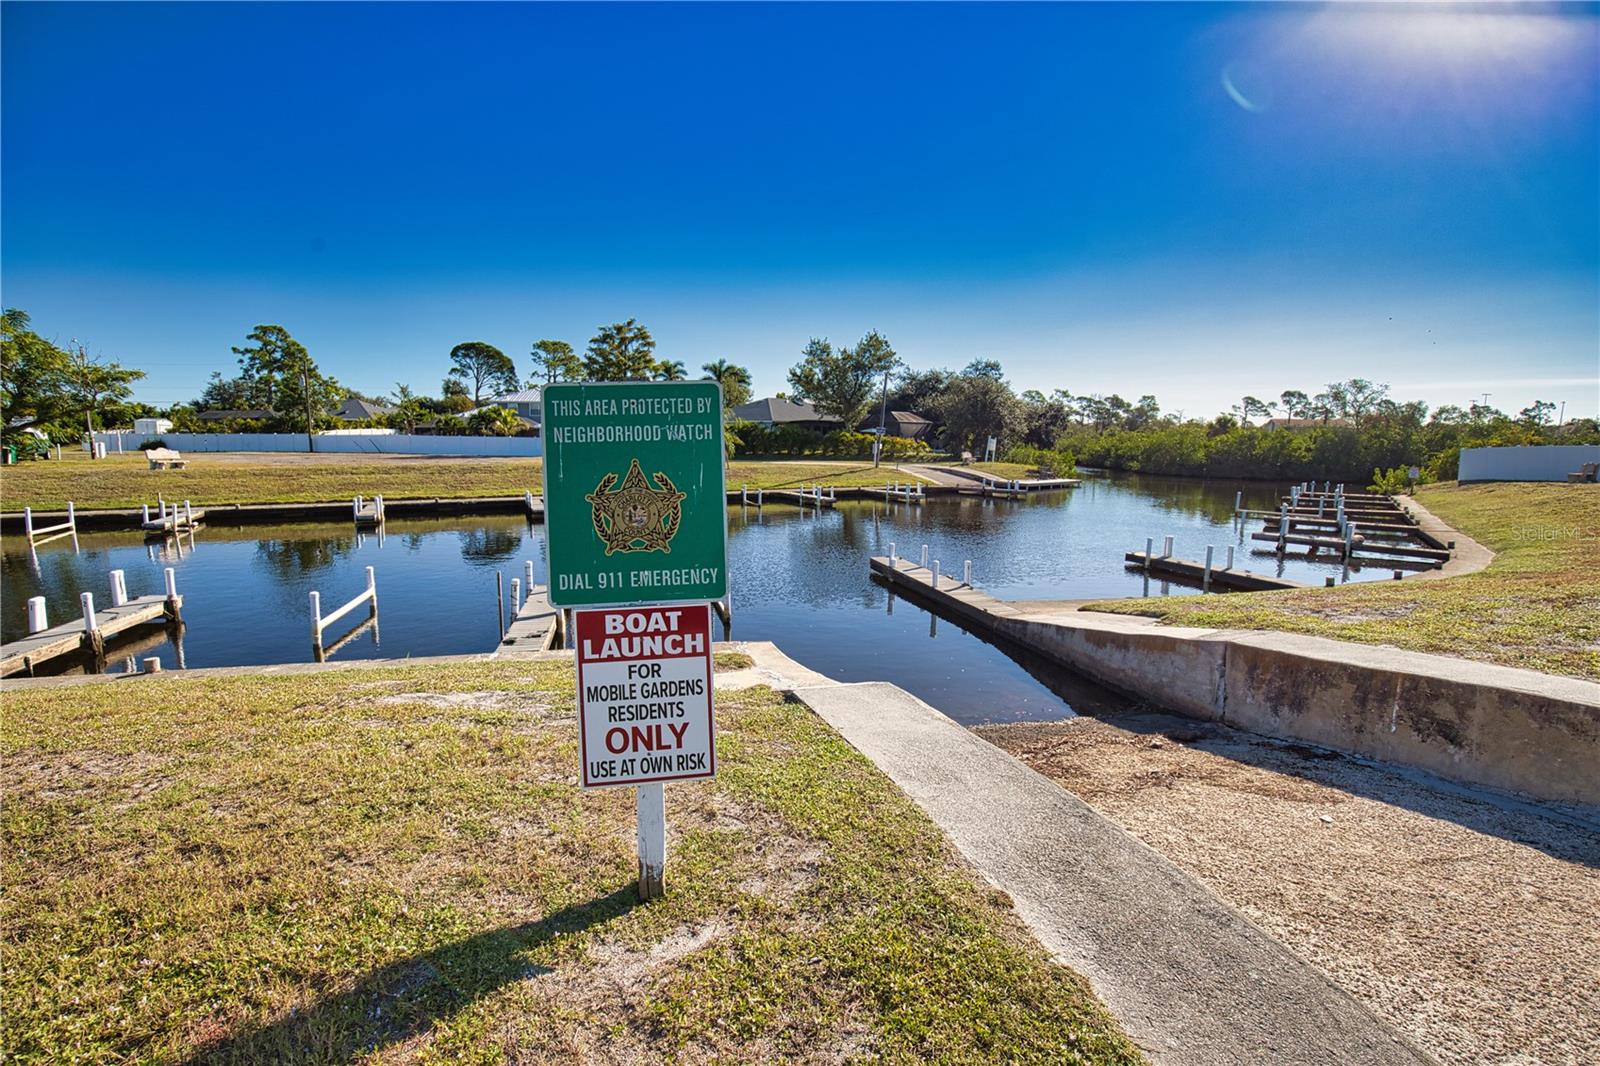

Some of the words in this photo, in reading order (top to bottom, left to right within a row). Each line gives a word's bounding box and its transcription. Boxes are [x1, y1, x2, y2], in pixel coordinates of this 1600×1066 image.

[552, 400, 580, 416] THIS
[585, 399, 618, 416] AREA
[622, 398, 692, 415] PROTECTED
[697, 397, 712, 414] BY
[554, 426, 661, 443] NEIGHBORHOOD
[667, 424, 712, 441] WATCH
[559, 573, 593, 590] DIAL
[598, 572, 623, 588] 911
[631, 568, 718, 587] EMERGENCY
[604, 611, 682, 635] BOAT
[583, 633, 704, 659] LAUNCH
[628, 663, 661, 679] FOR
[587, 684, 636, 703] MOBILE
[641, 679, 703, 699] GARDENS
[608, 701, 684, 722] RESIDENTS
[605, 722, 690, 754] ONLY
[590, 760, 616, 778] USE
[620, 758, 636, 775] AT
[640, 756, 672, 774] OWN
[677, 753, 706, 771] RISK
